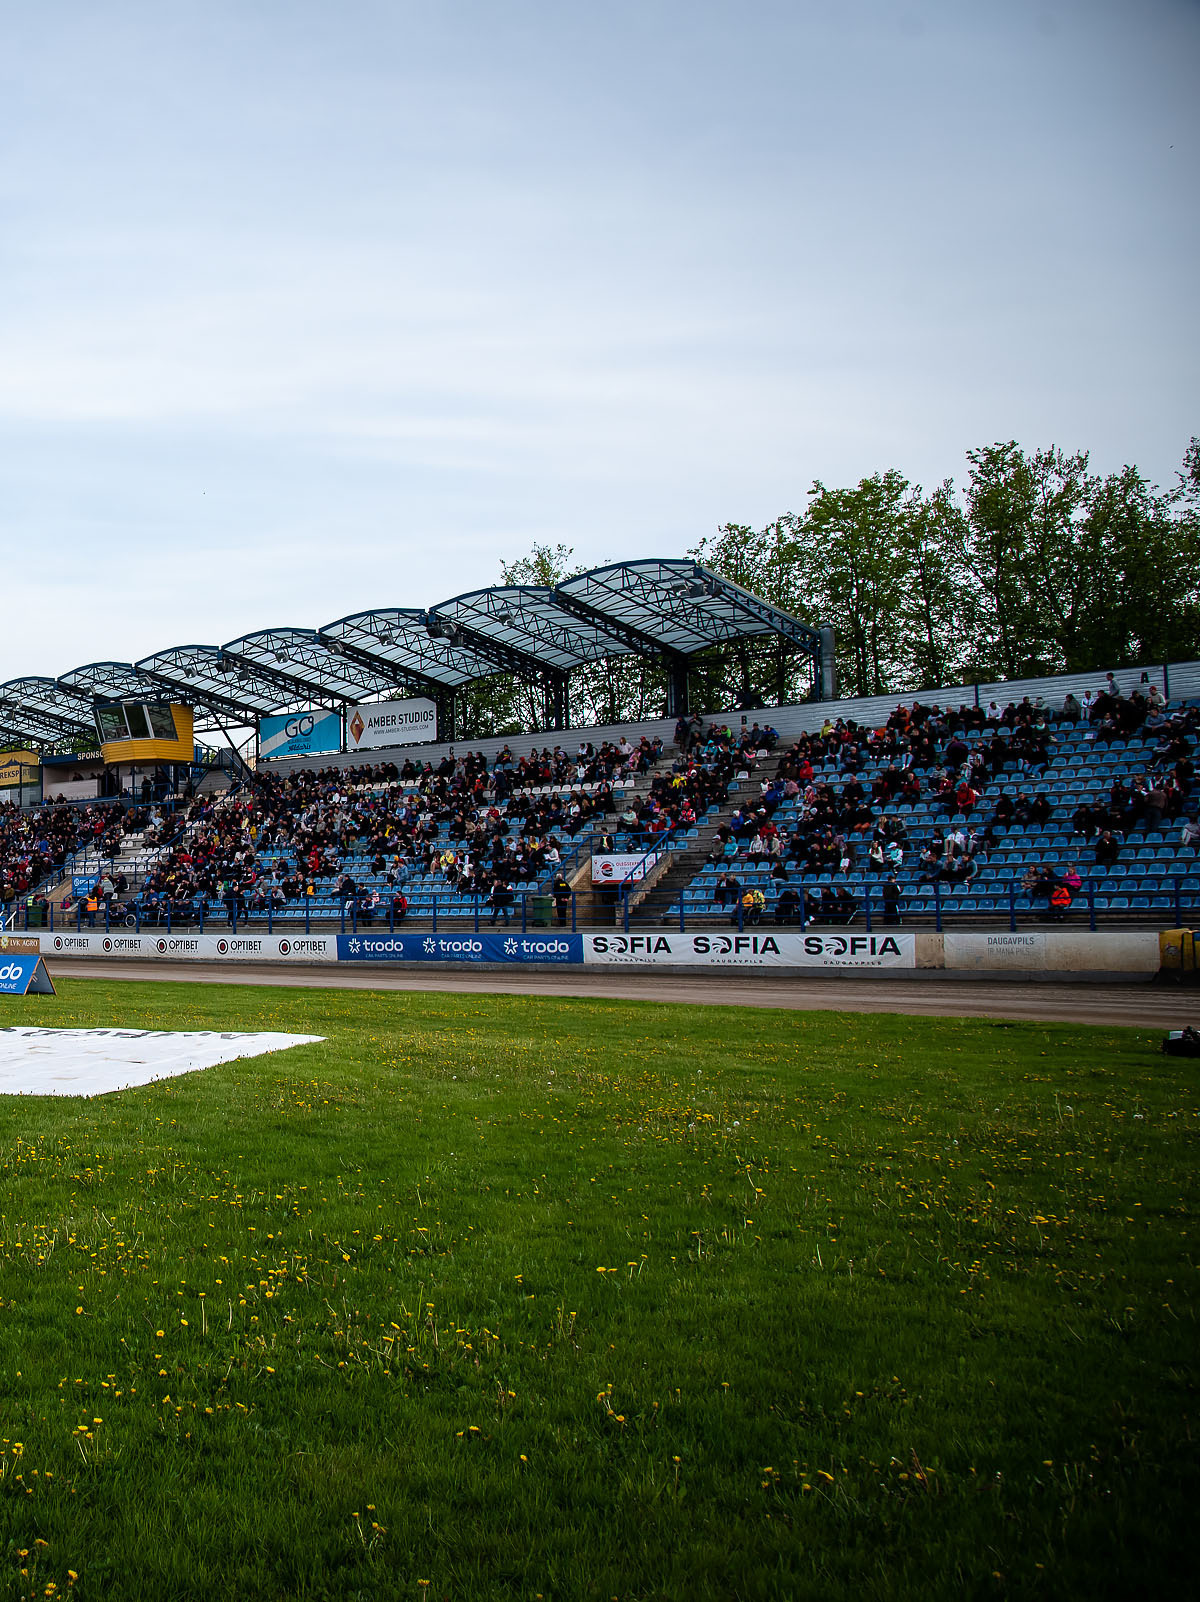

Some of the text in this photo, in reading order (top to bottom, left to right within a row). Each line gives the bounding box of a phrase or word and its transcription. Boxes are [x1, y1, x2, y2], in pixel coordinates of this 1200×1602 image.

[367, 709, 434, 729] AMBER STUDIOS
[22, 939, 38, 947] AGRO
[64, 938, 89, 948] OPTIBET
[114, 939, 142, 949] OPTIBET
[168, 939, 199, 950] OPTIBET
[230, 940, 262, 951] OPTIBET
[293, 940, 327, 951] OPTIBET
[362, 938, 404, 952] trodo
[438, 938, 482, 952] trodo
[521, 939, 570, 953] trodo
[592, 936, 672, 954] SOFIA
[693, 936, 781, 955] SOFIA
[804, 936, 902, 956] SOFIA
[987, 936, 1035, 945] DAUGAVPILS
